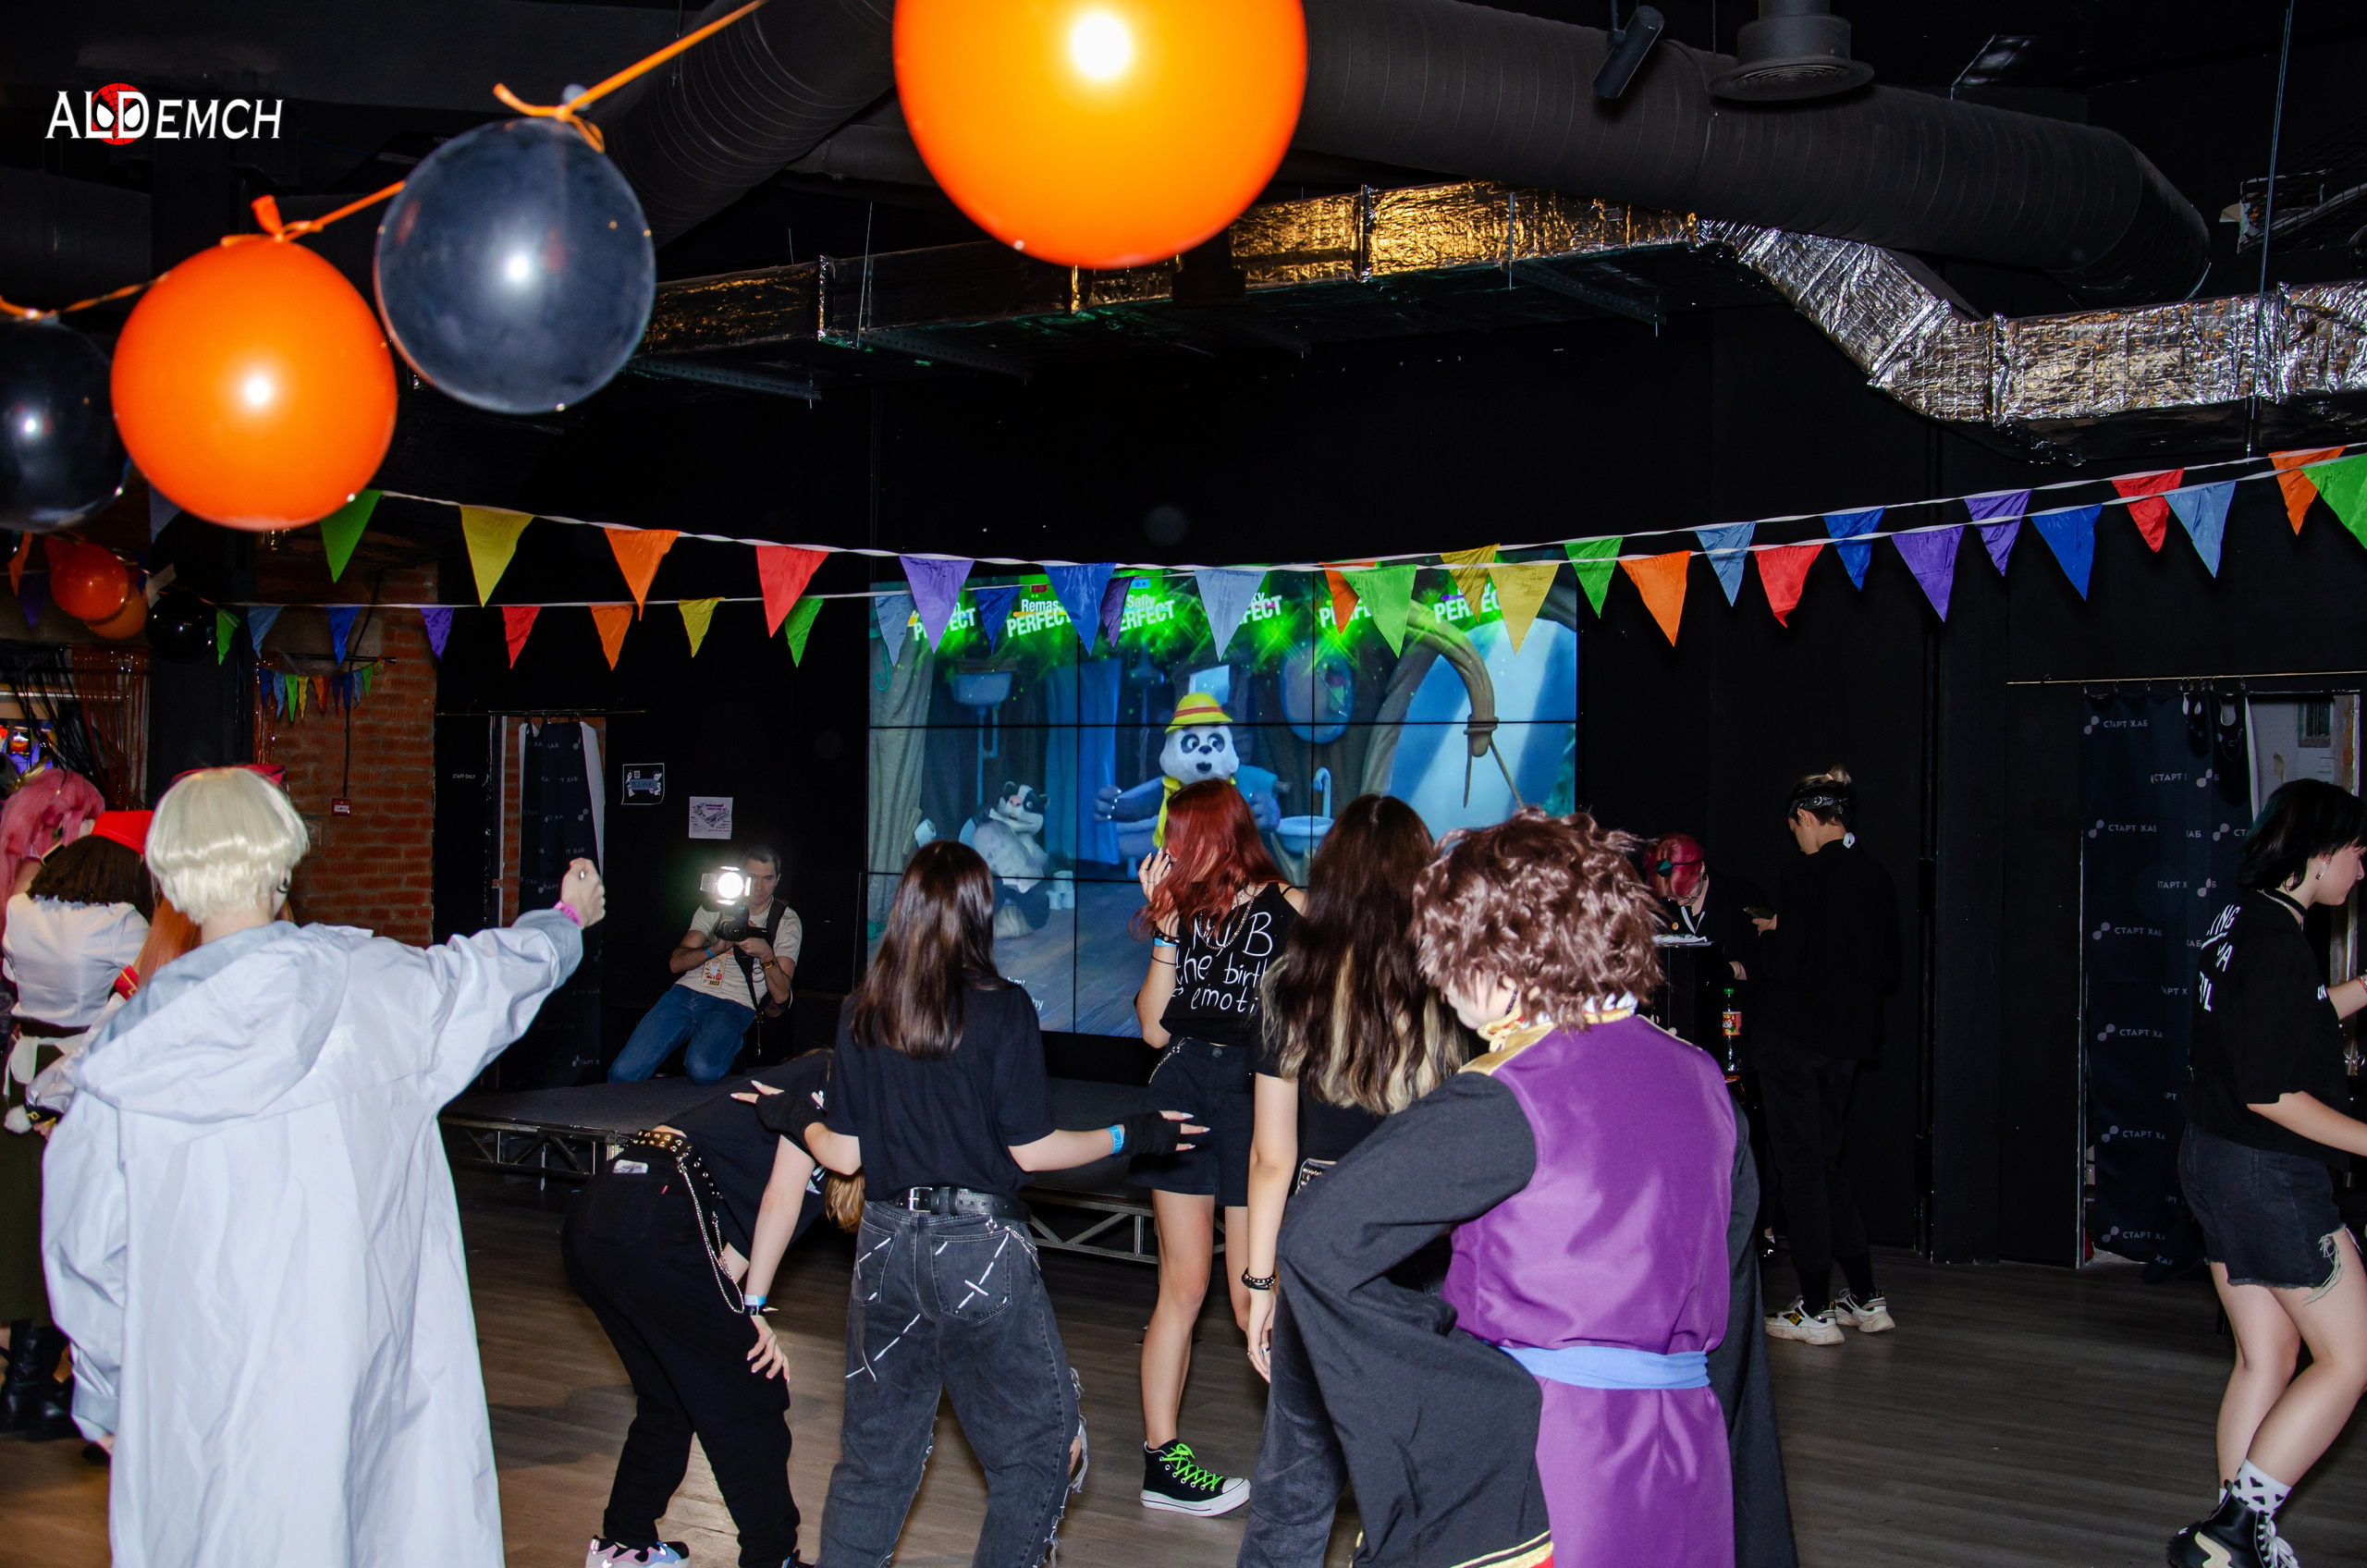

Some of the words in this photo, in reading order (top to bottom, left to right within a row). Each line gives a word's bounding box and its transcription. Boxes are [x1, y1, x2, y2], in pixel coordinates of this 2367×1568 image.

[1120, 599, 1175, 632] ERFECT
[914, 607, 976, 641] PECT
[2108, 824, 2137, 833] СТАРТ
[2114, 927, 2144, 936] СТАРТ
[2118, 1028, 2150, 1036] СТАРТ
[2122, 1130, 2152, 1138] СТАРТ
[2122, 1231, 2152, 1239] СТАРТ
